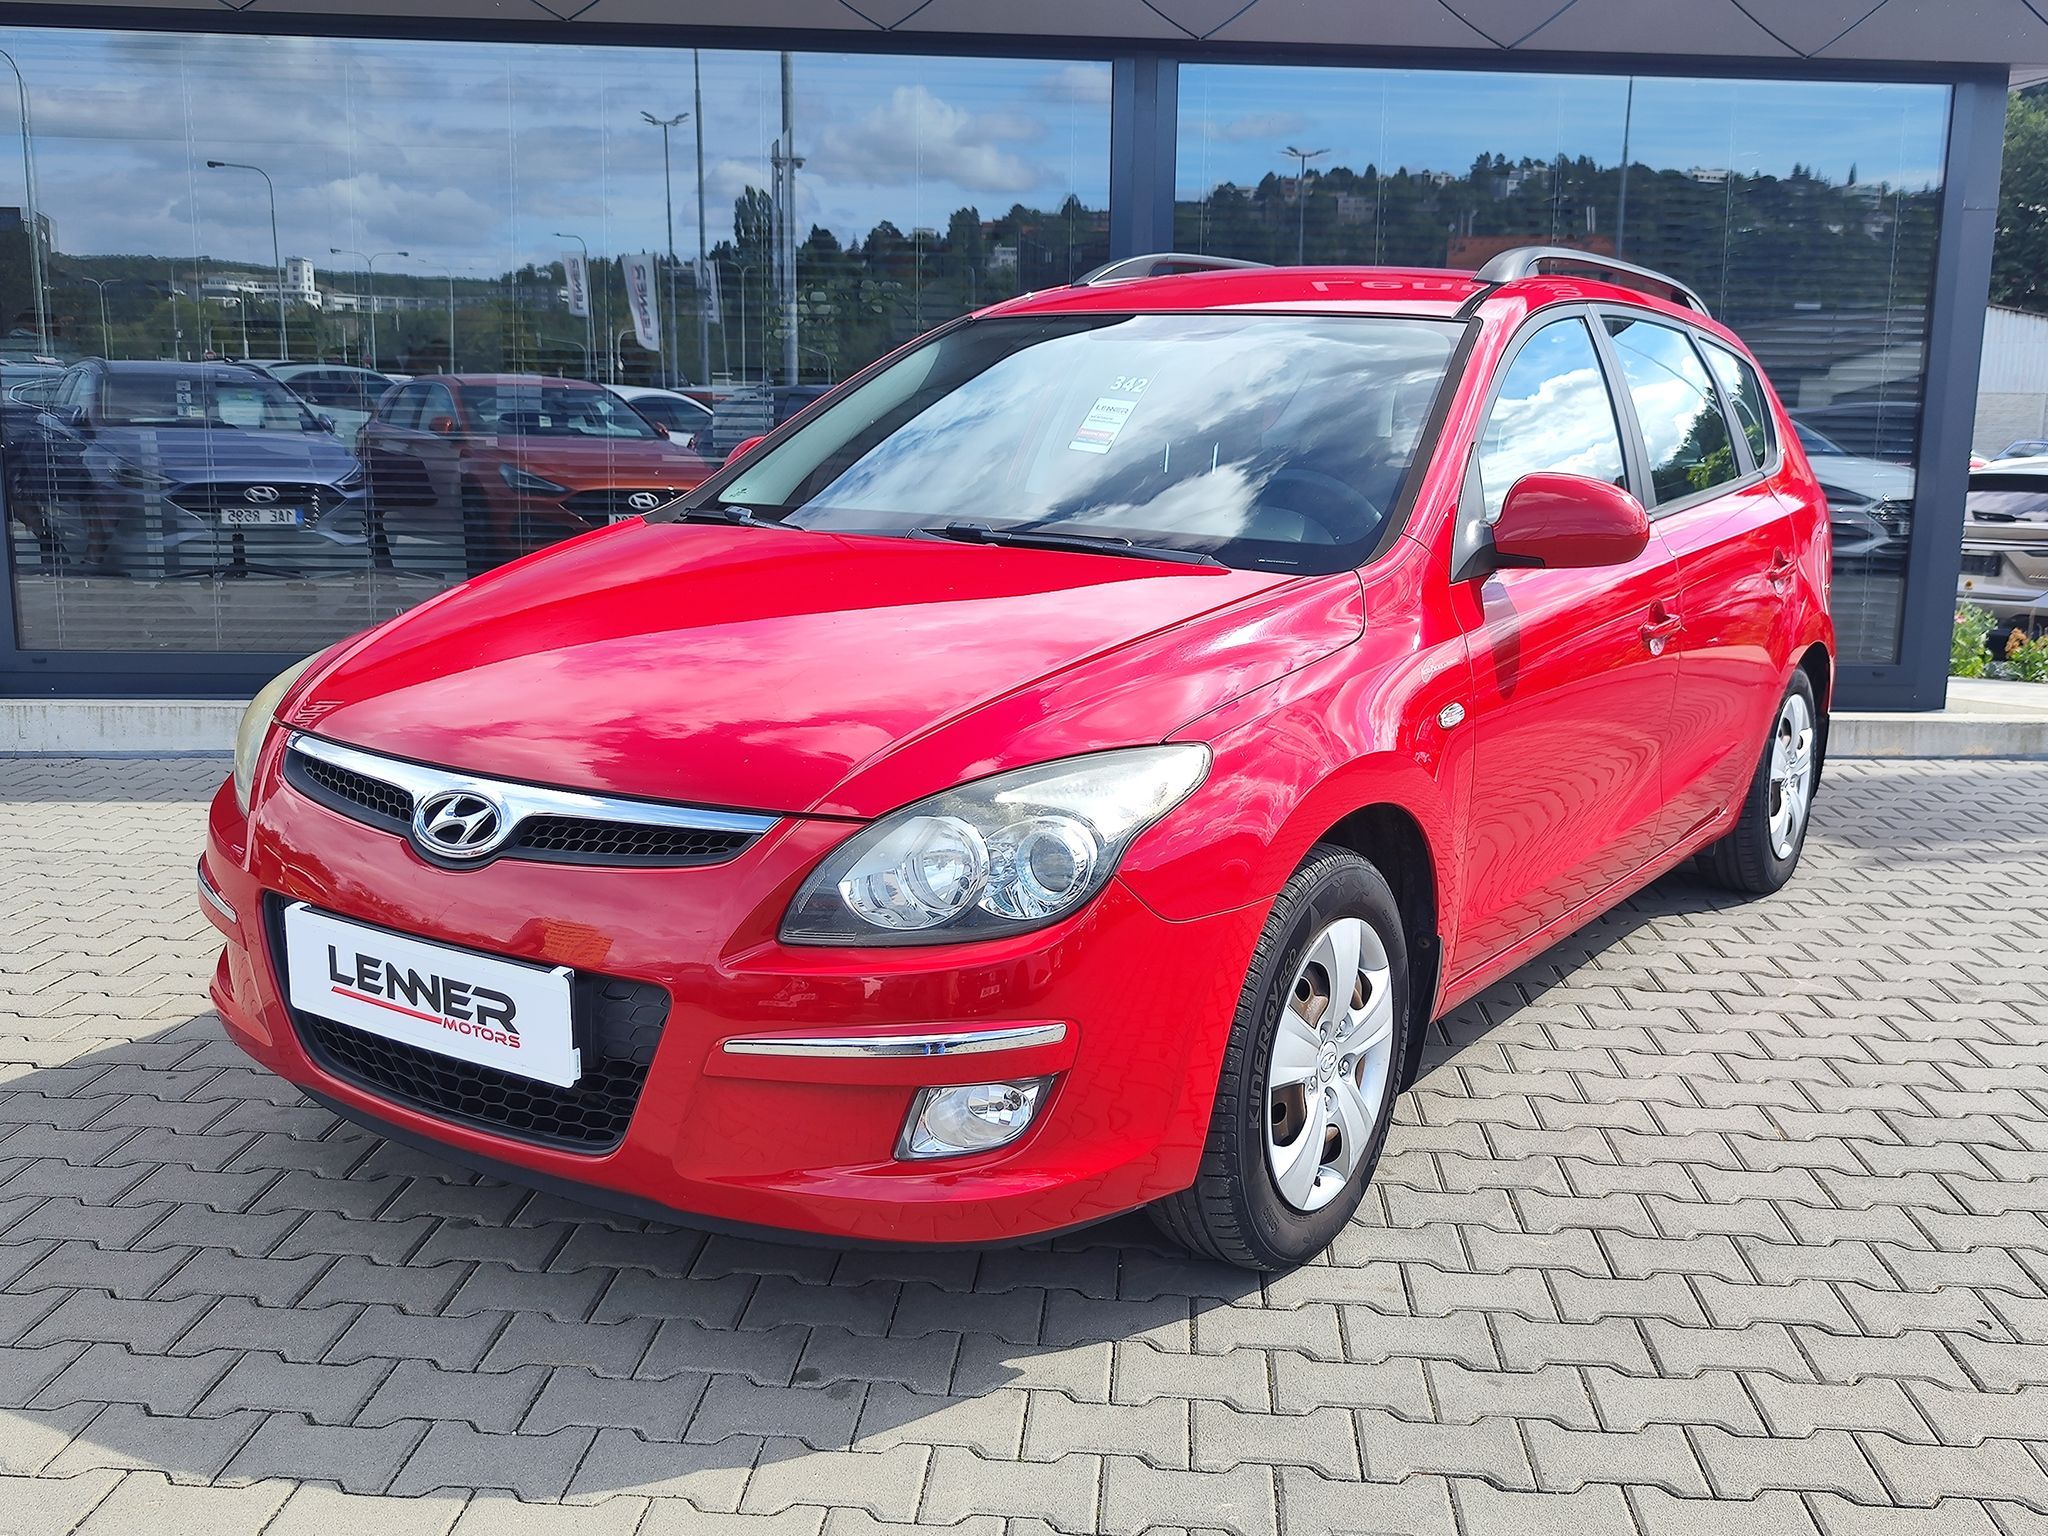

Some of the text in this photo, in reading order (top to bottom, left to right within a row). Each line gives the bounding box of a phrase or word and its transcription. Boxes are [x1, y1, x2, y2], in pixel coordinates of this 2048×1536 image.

[1110, 375, 1148, 393] 342
[327, 944, 520, 1035] LENNER
[443, 1017, 521, 1049] MOTORS
